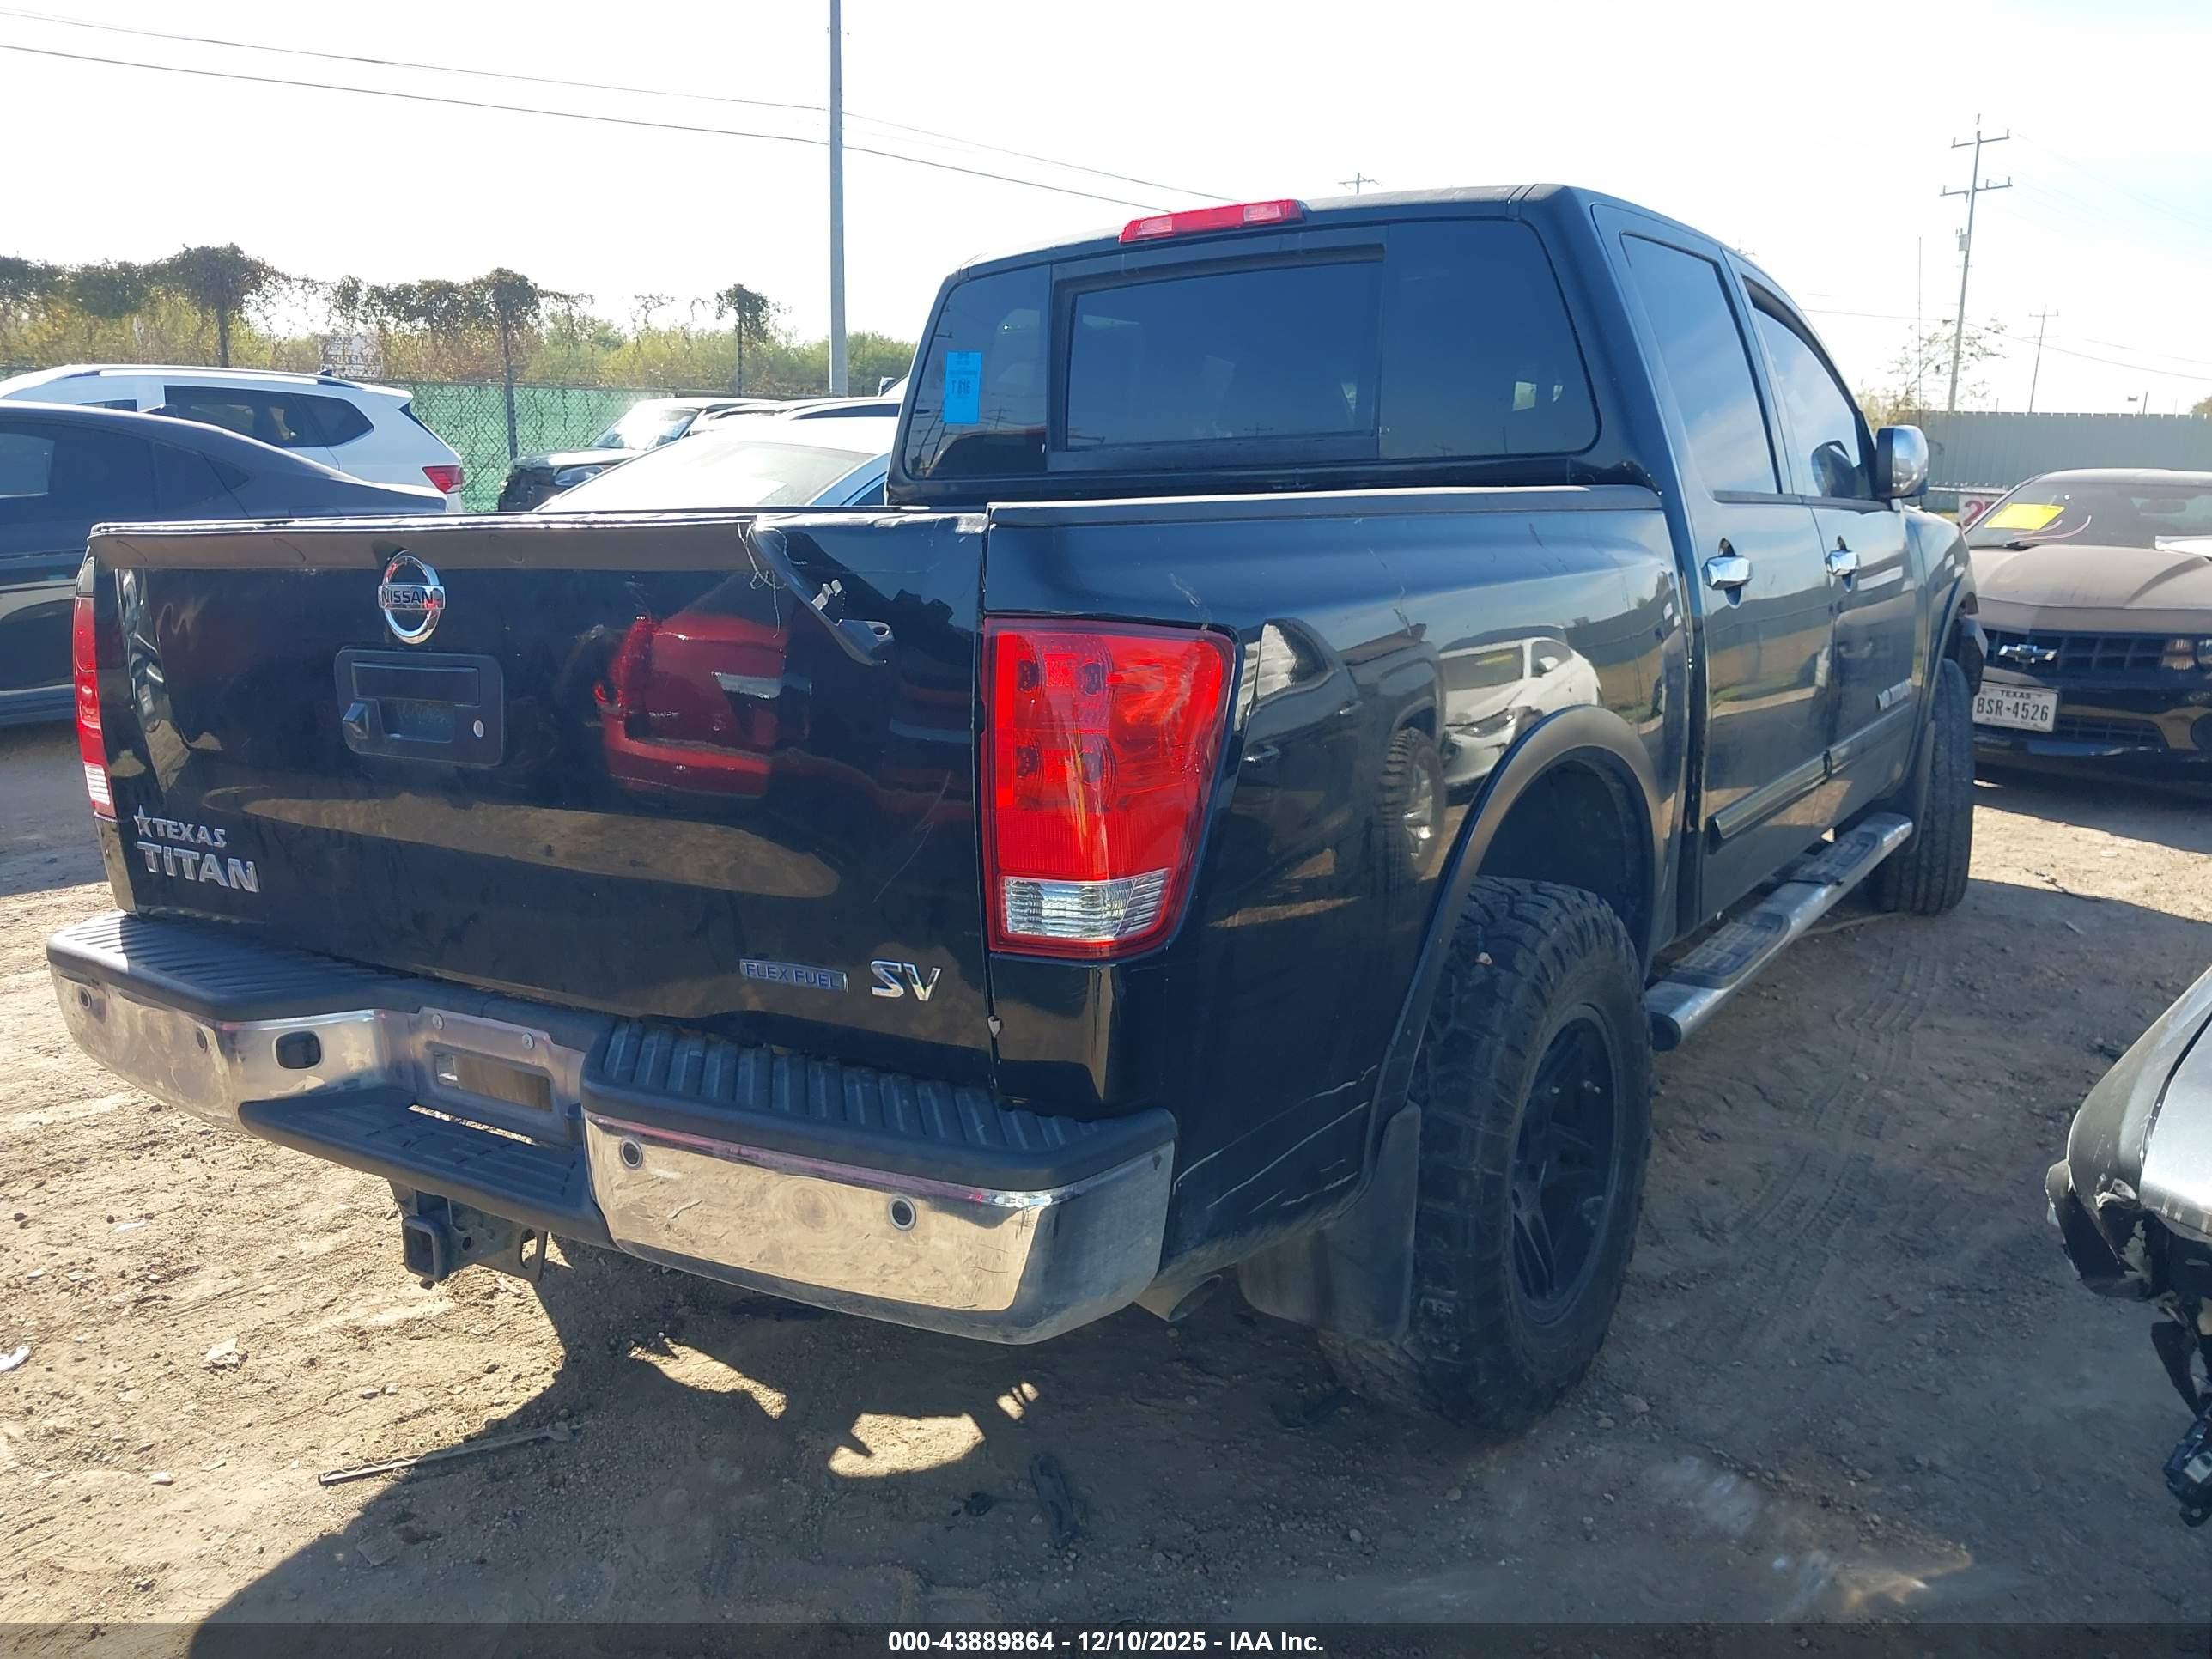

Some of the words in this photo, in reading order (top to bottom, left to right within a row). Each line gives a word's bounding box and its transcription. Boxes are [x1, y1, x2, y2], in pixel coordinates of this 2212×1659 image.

[381, 589, 434, 605] NISSAN
[2000, 690, 2032, 700] TEXAS
[152, 817, 227, 848] TEXAS
[137, 841, 260, 893] TITAN
[745, 963, 788, 981] FLEX
[793, 969, 840, 988] FUEL
[871, 960, 942, 1002] SV
